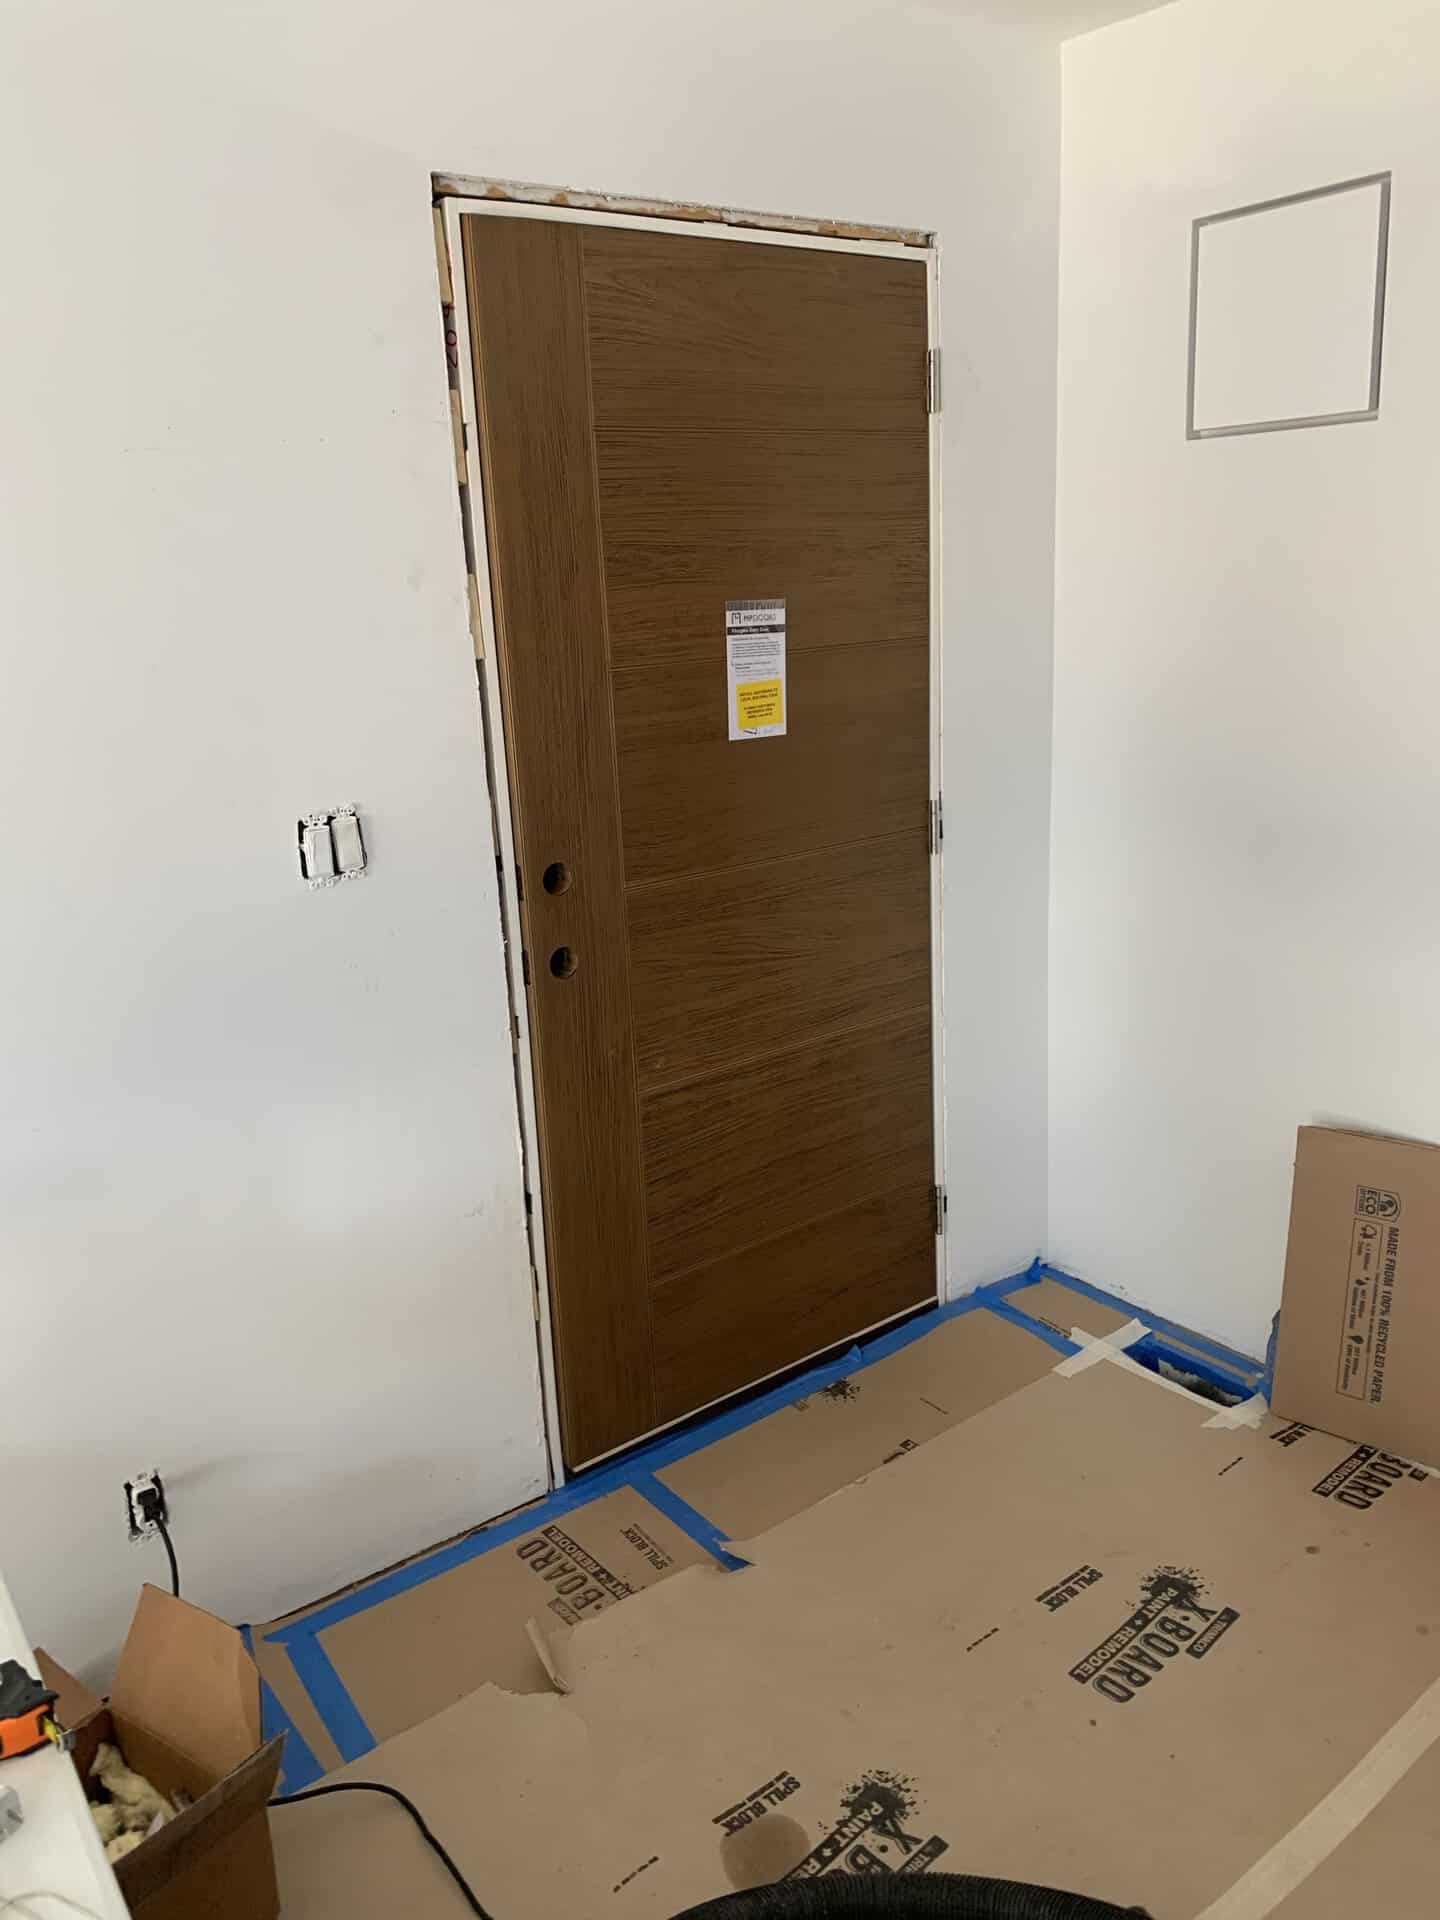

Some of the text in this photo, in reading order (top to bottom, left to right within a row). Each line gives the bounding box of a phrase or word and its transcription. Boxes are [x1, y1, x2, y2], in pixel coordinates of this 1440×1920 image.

[1365, 1189, 1377, 1215] ECO
[1386, 1226, 1400, 1257] MADE
[1383, 1258, 1397, 1288] FROM
[1379, 1289, 1393, 1317] 100%
[1374, 1318, 1390, 1369] RECYCLED
[1369, 1368, 1384, 1403] PAPER
[1077, 1567, 1104, 1591] SPILL
[1043, 1584, 1081, 1613] BLOCK
[1071, 1586, 1180, 1680] PAINT REMODEL
[766, 1775, 801, 1807] SPILL
[720, 1799, 768, 1837] BLOCK
[836, 1800, 884, 1848] PAINT
